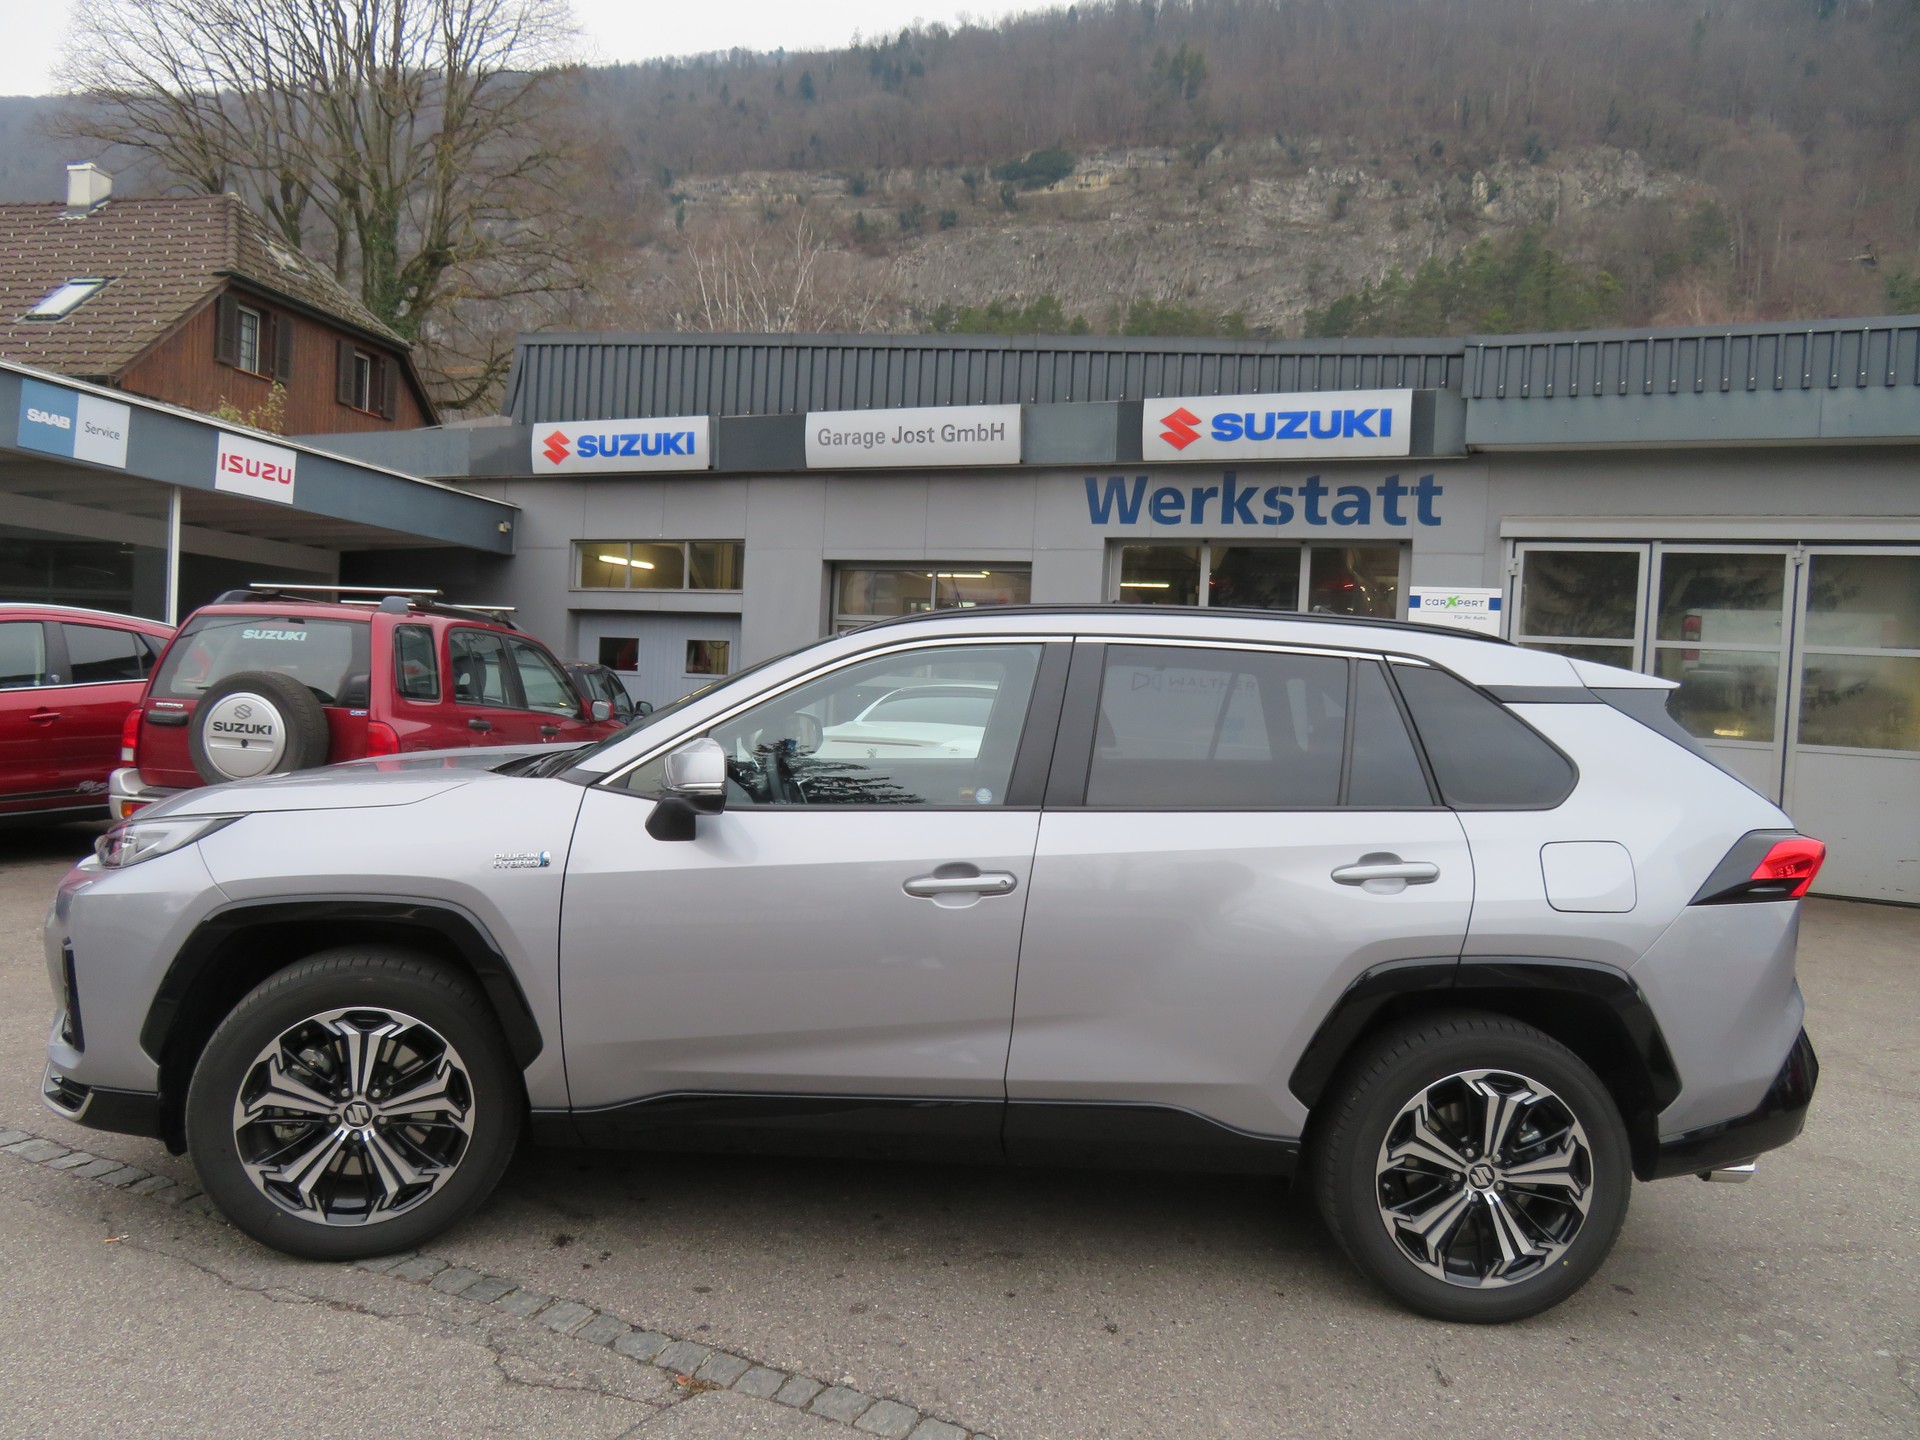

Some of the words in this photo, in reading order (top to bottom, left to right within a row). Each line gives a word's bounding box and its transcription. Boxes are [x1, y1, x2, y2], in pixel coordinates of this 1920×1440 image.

[27, 408, 71, 430] SAAB
[84, 421, 120, 440] Service
[817, 428, 886, 449] Garage
[891, 426, 935, 444] Jost
[940, 422, 1005, 443] GmbH
[1210, 408, 1393, 442] SUZUKI
[577, 431, 695, 458] SUZUKI
[220, 452, 292, 485] ISUZU
[1084, 471, 1443, 527] Werkstatt
[241, 629, 307, 642] SUZUKI
[213, 721, 272, 736] SUZUKI
